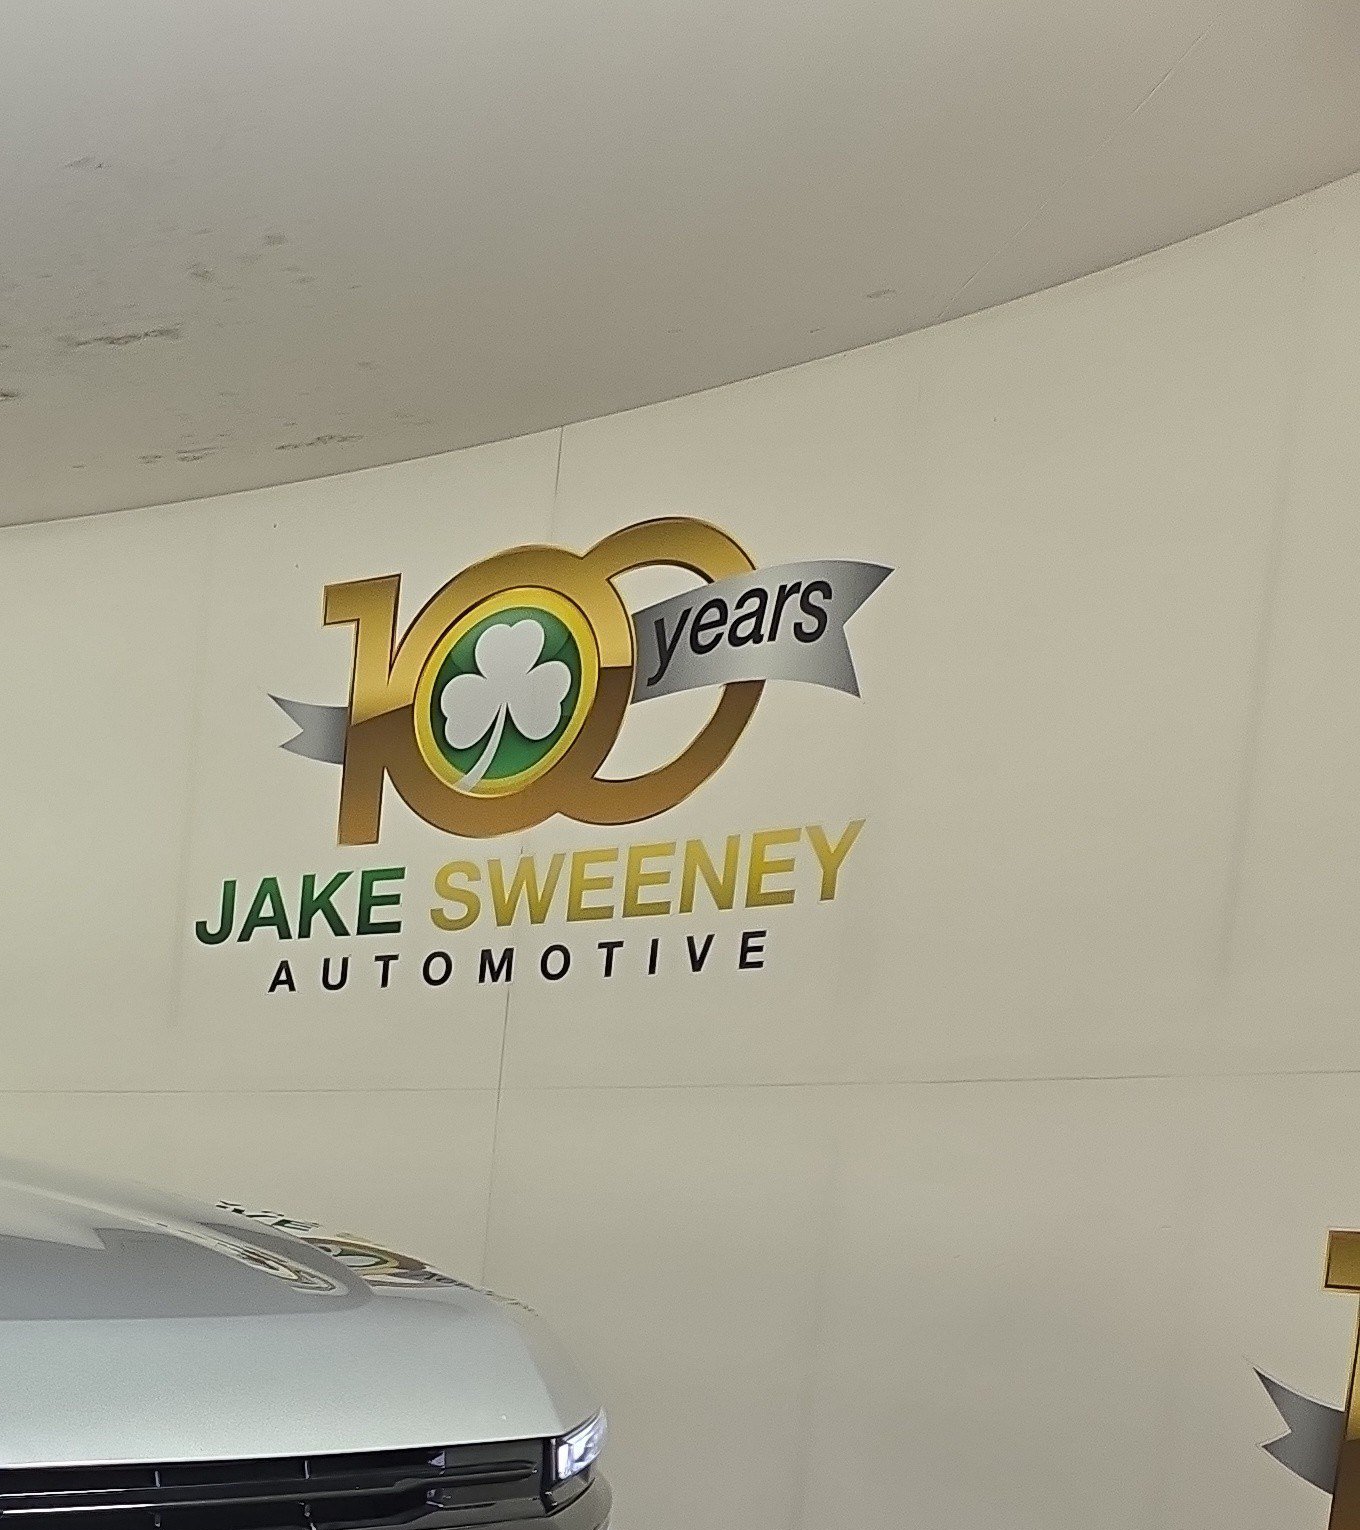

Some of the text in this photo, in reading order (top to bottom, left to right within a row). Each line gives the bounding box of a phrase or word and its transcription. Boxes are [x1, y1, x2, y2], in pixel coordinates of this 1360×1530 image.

[646, 579, 832, 688] years
[195, 820, 866, 947] JAKE SWEENEY
[267, 931, 768, 994] AUTOMOTIVE
